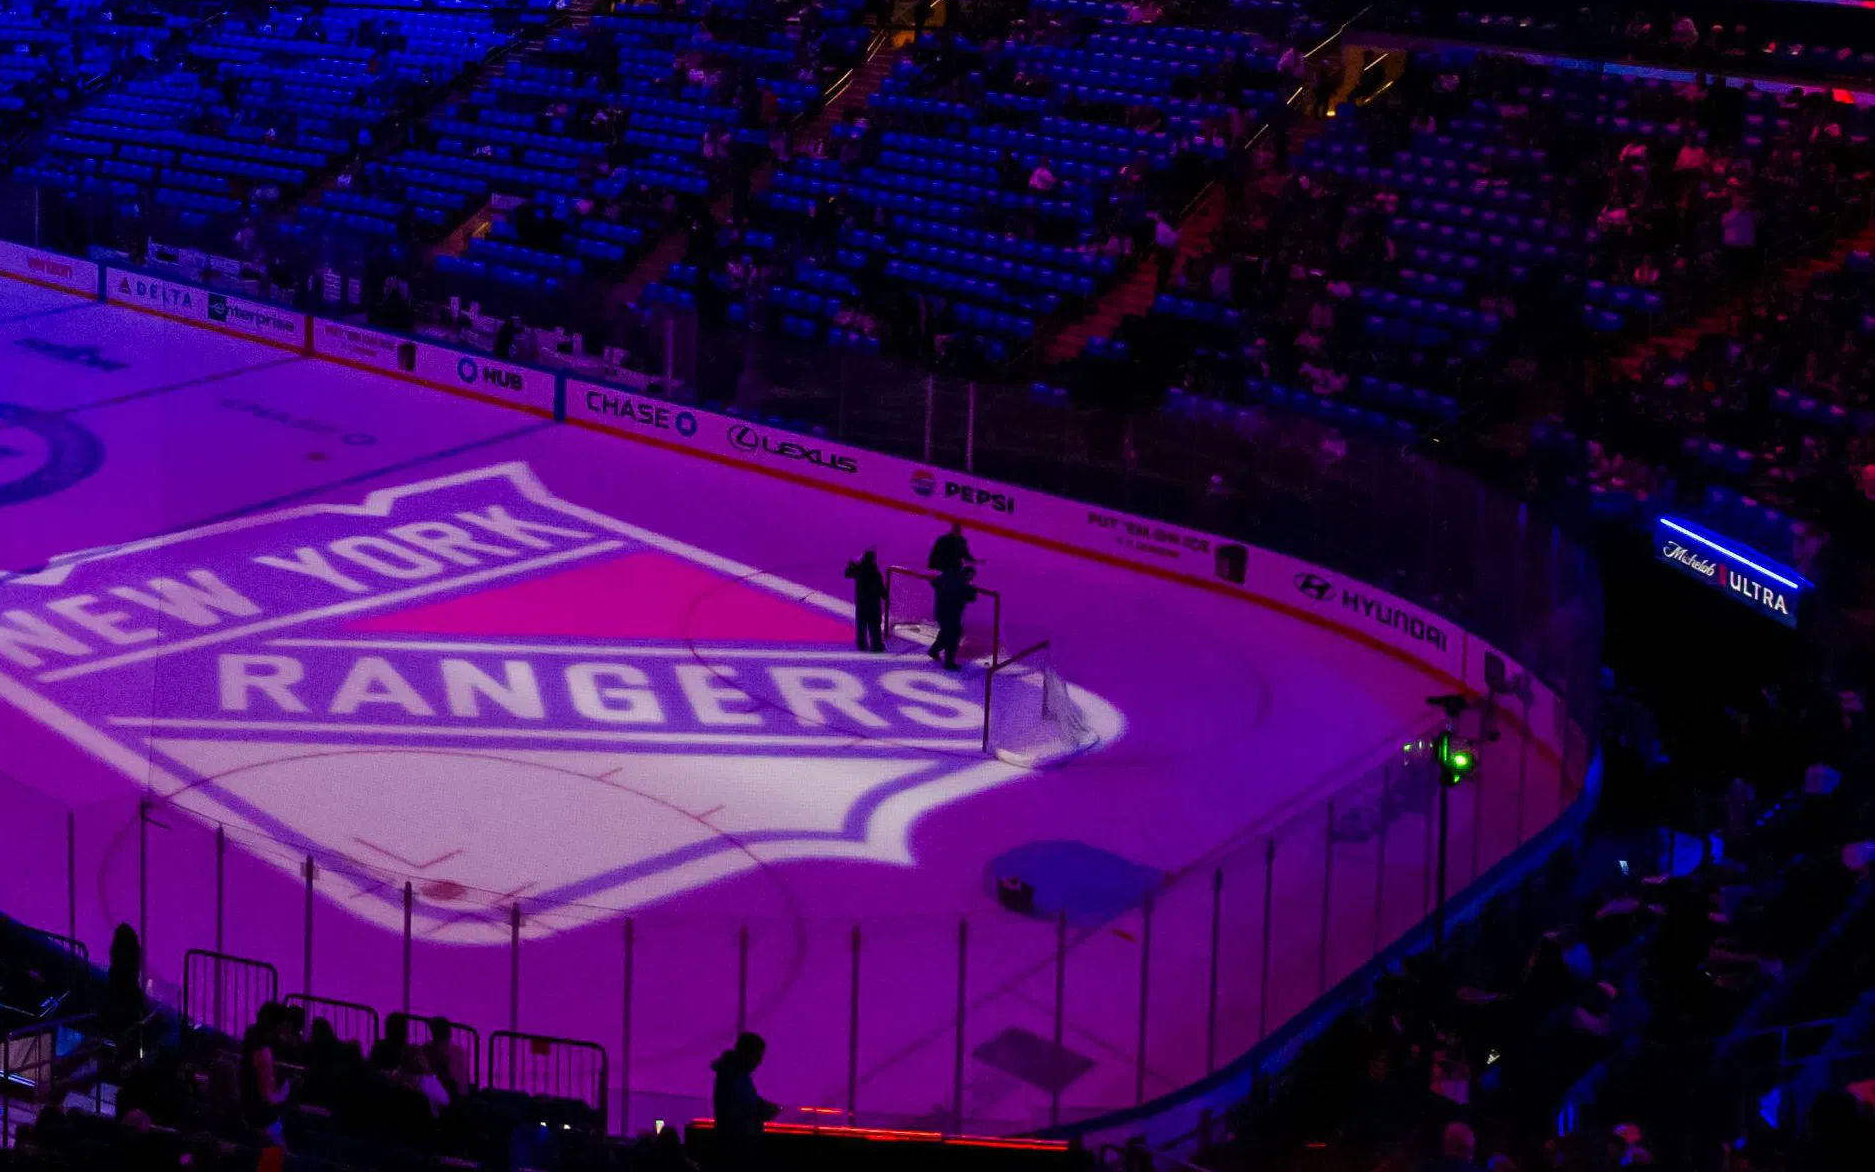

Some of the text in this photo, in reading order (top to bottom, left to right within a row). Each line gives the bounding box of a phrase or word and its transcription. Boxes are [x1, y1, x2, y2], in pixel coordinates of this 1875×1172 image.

[136, 281, 193, 310] DELTA
[481, 367, 523, 390] HUB
[586, 390, 670, 430] CHASE
[762, 441, 858, 474] LEXUS
[944, 481, 1014, 515] PEPSI
[251, 504, 597, 593] YORK
[1662, 540, 1790, 615] Michelob ULTRA
[1341, 588, 1448, 653] HYUNDAI
[219, 650, 987, 730] RANGERS
